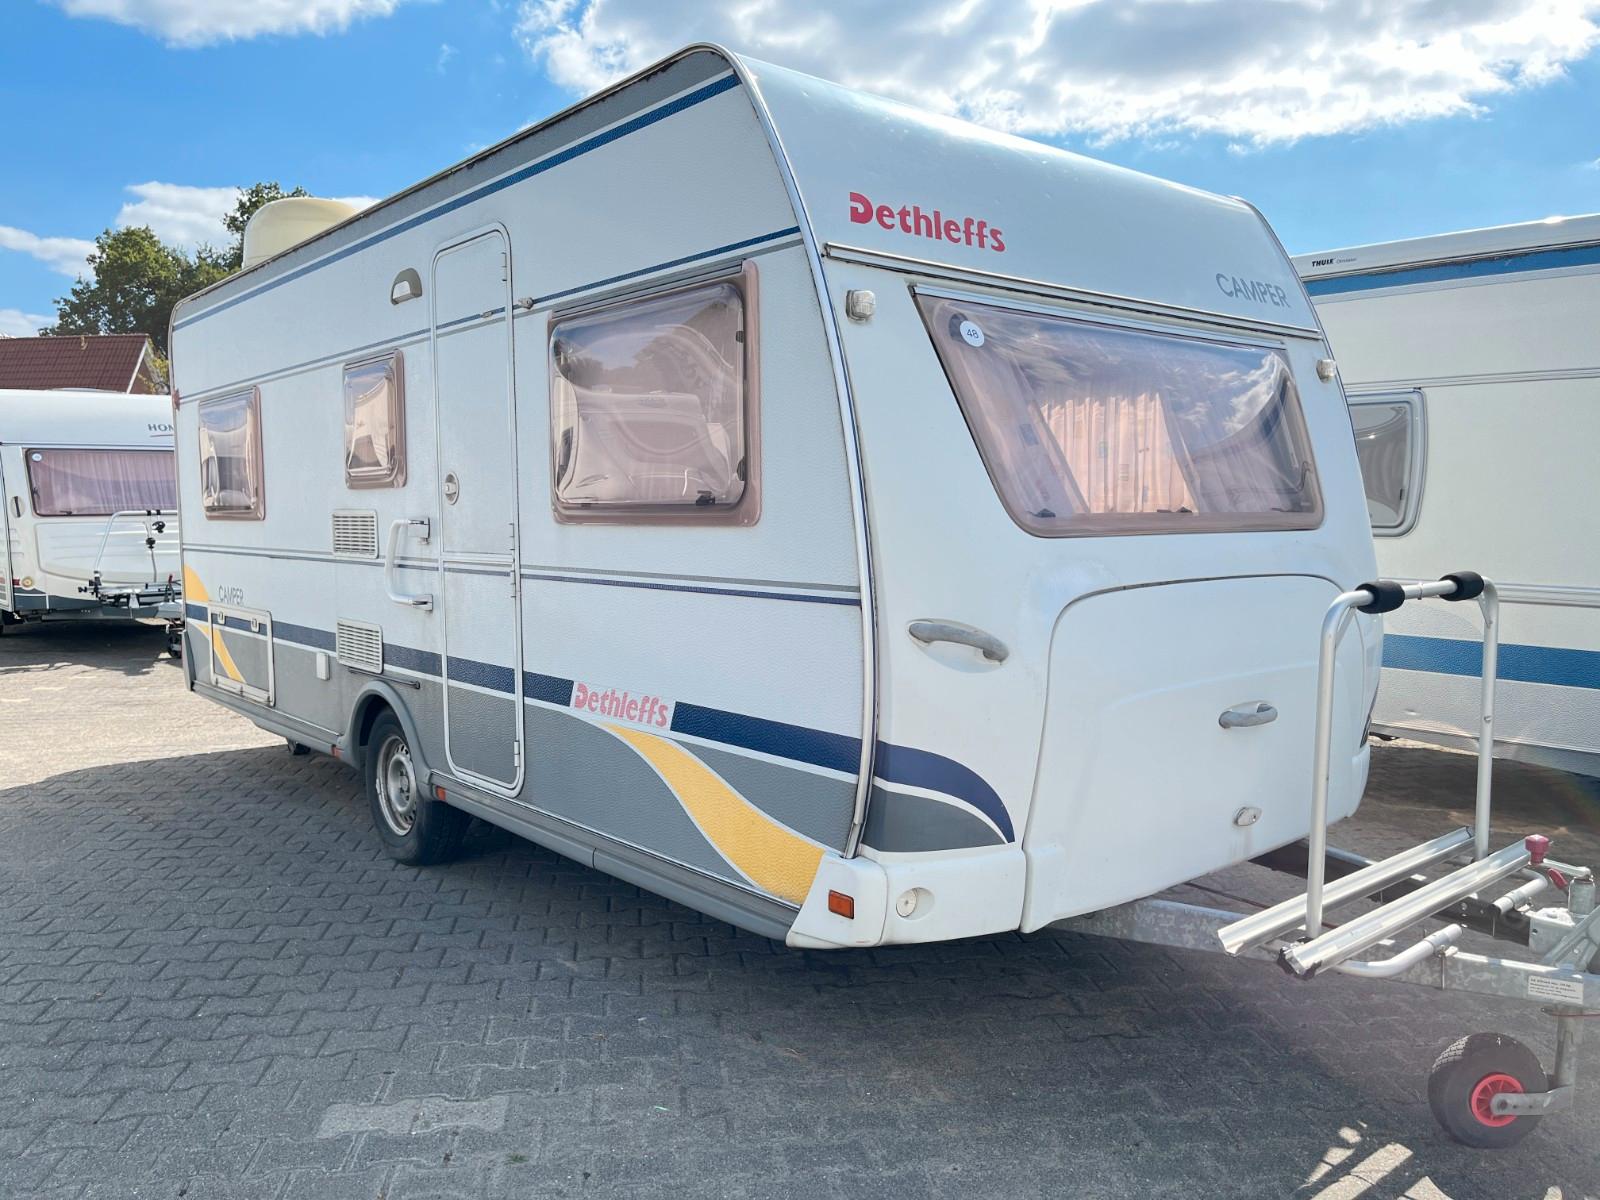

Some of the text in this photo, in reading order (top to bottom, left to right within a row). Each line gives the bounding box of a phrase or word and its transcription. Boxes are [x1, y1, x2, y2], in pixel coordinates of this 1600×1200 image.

[849, 192, 1005, 252] Dethleffs
[1216, 273, 1290, 308] CAMPER
[966, 328, 979, 339] 48
[219, 585, 244, 606] CAMPER
[575, 683, 669, 728] Dethleffs
